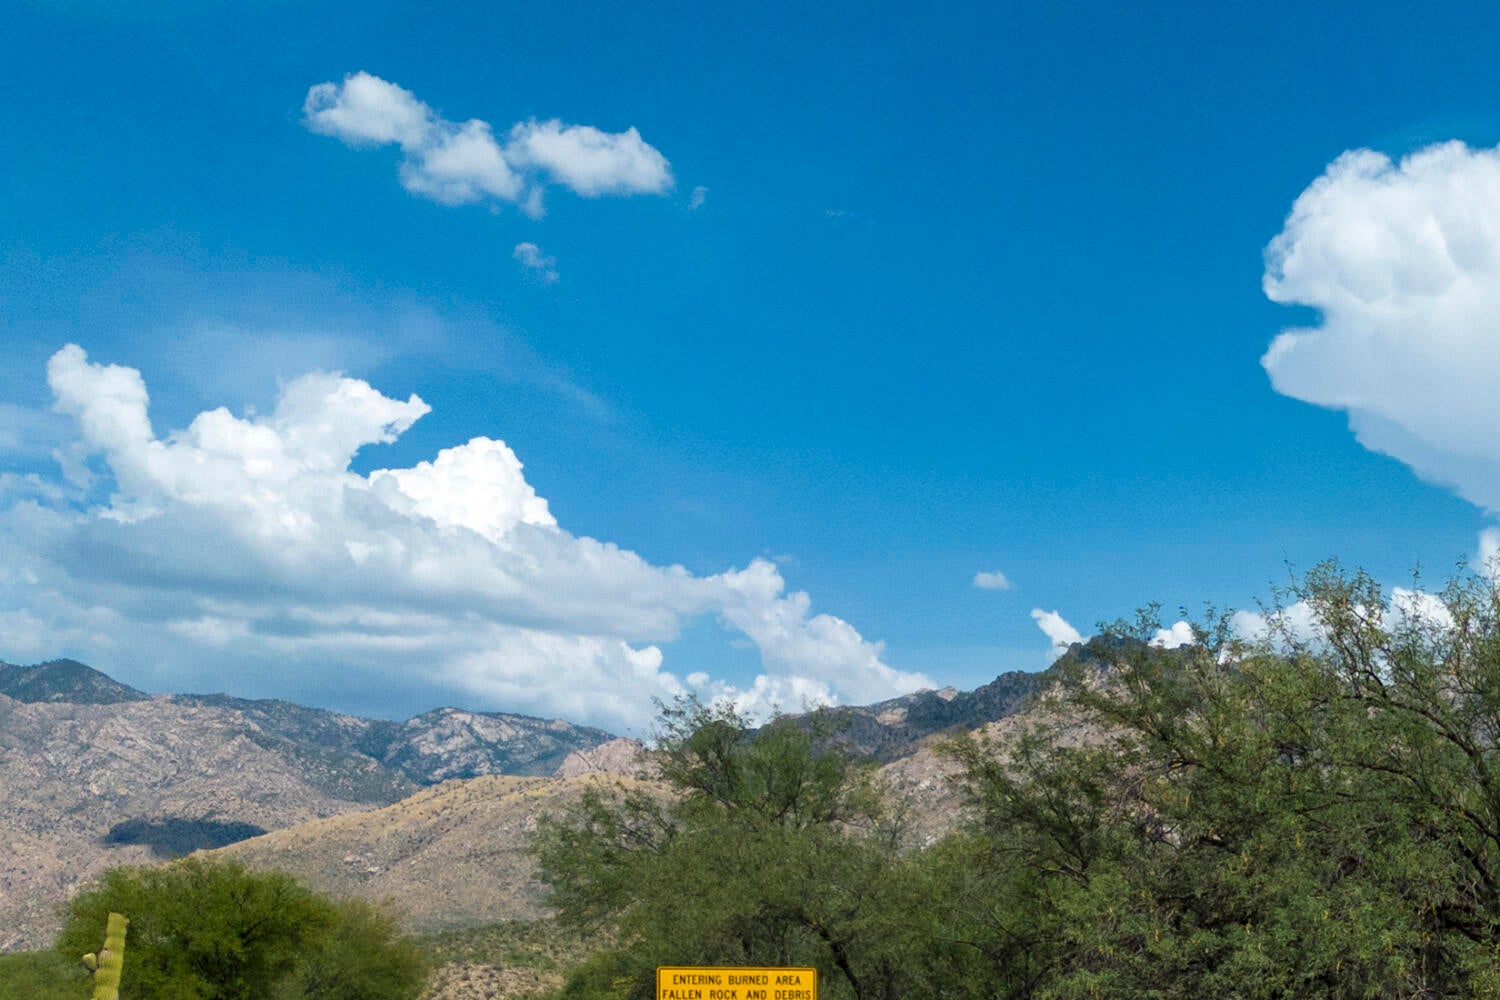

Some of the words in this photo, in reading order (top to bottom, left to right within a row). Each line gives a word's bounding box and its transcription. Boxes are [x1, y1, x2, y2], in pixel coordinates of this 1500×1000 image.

[673, 975, 721, 985] ENTERING
[729, 975, 768, 985] BURNED
[776, 976, 801, 985] AREA
[663, 990, 701, 1000] FALLEN
[710, 990, 737, 1000] ROCK
[747, 990, 766, 1000] AND
[775, 991, 810, 1000] DEBRIS
